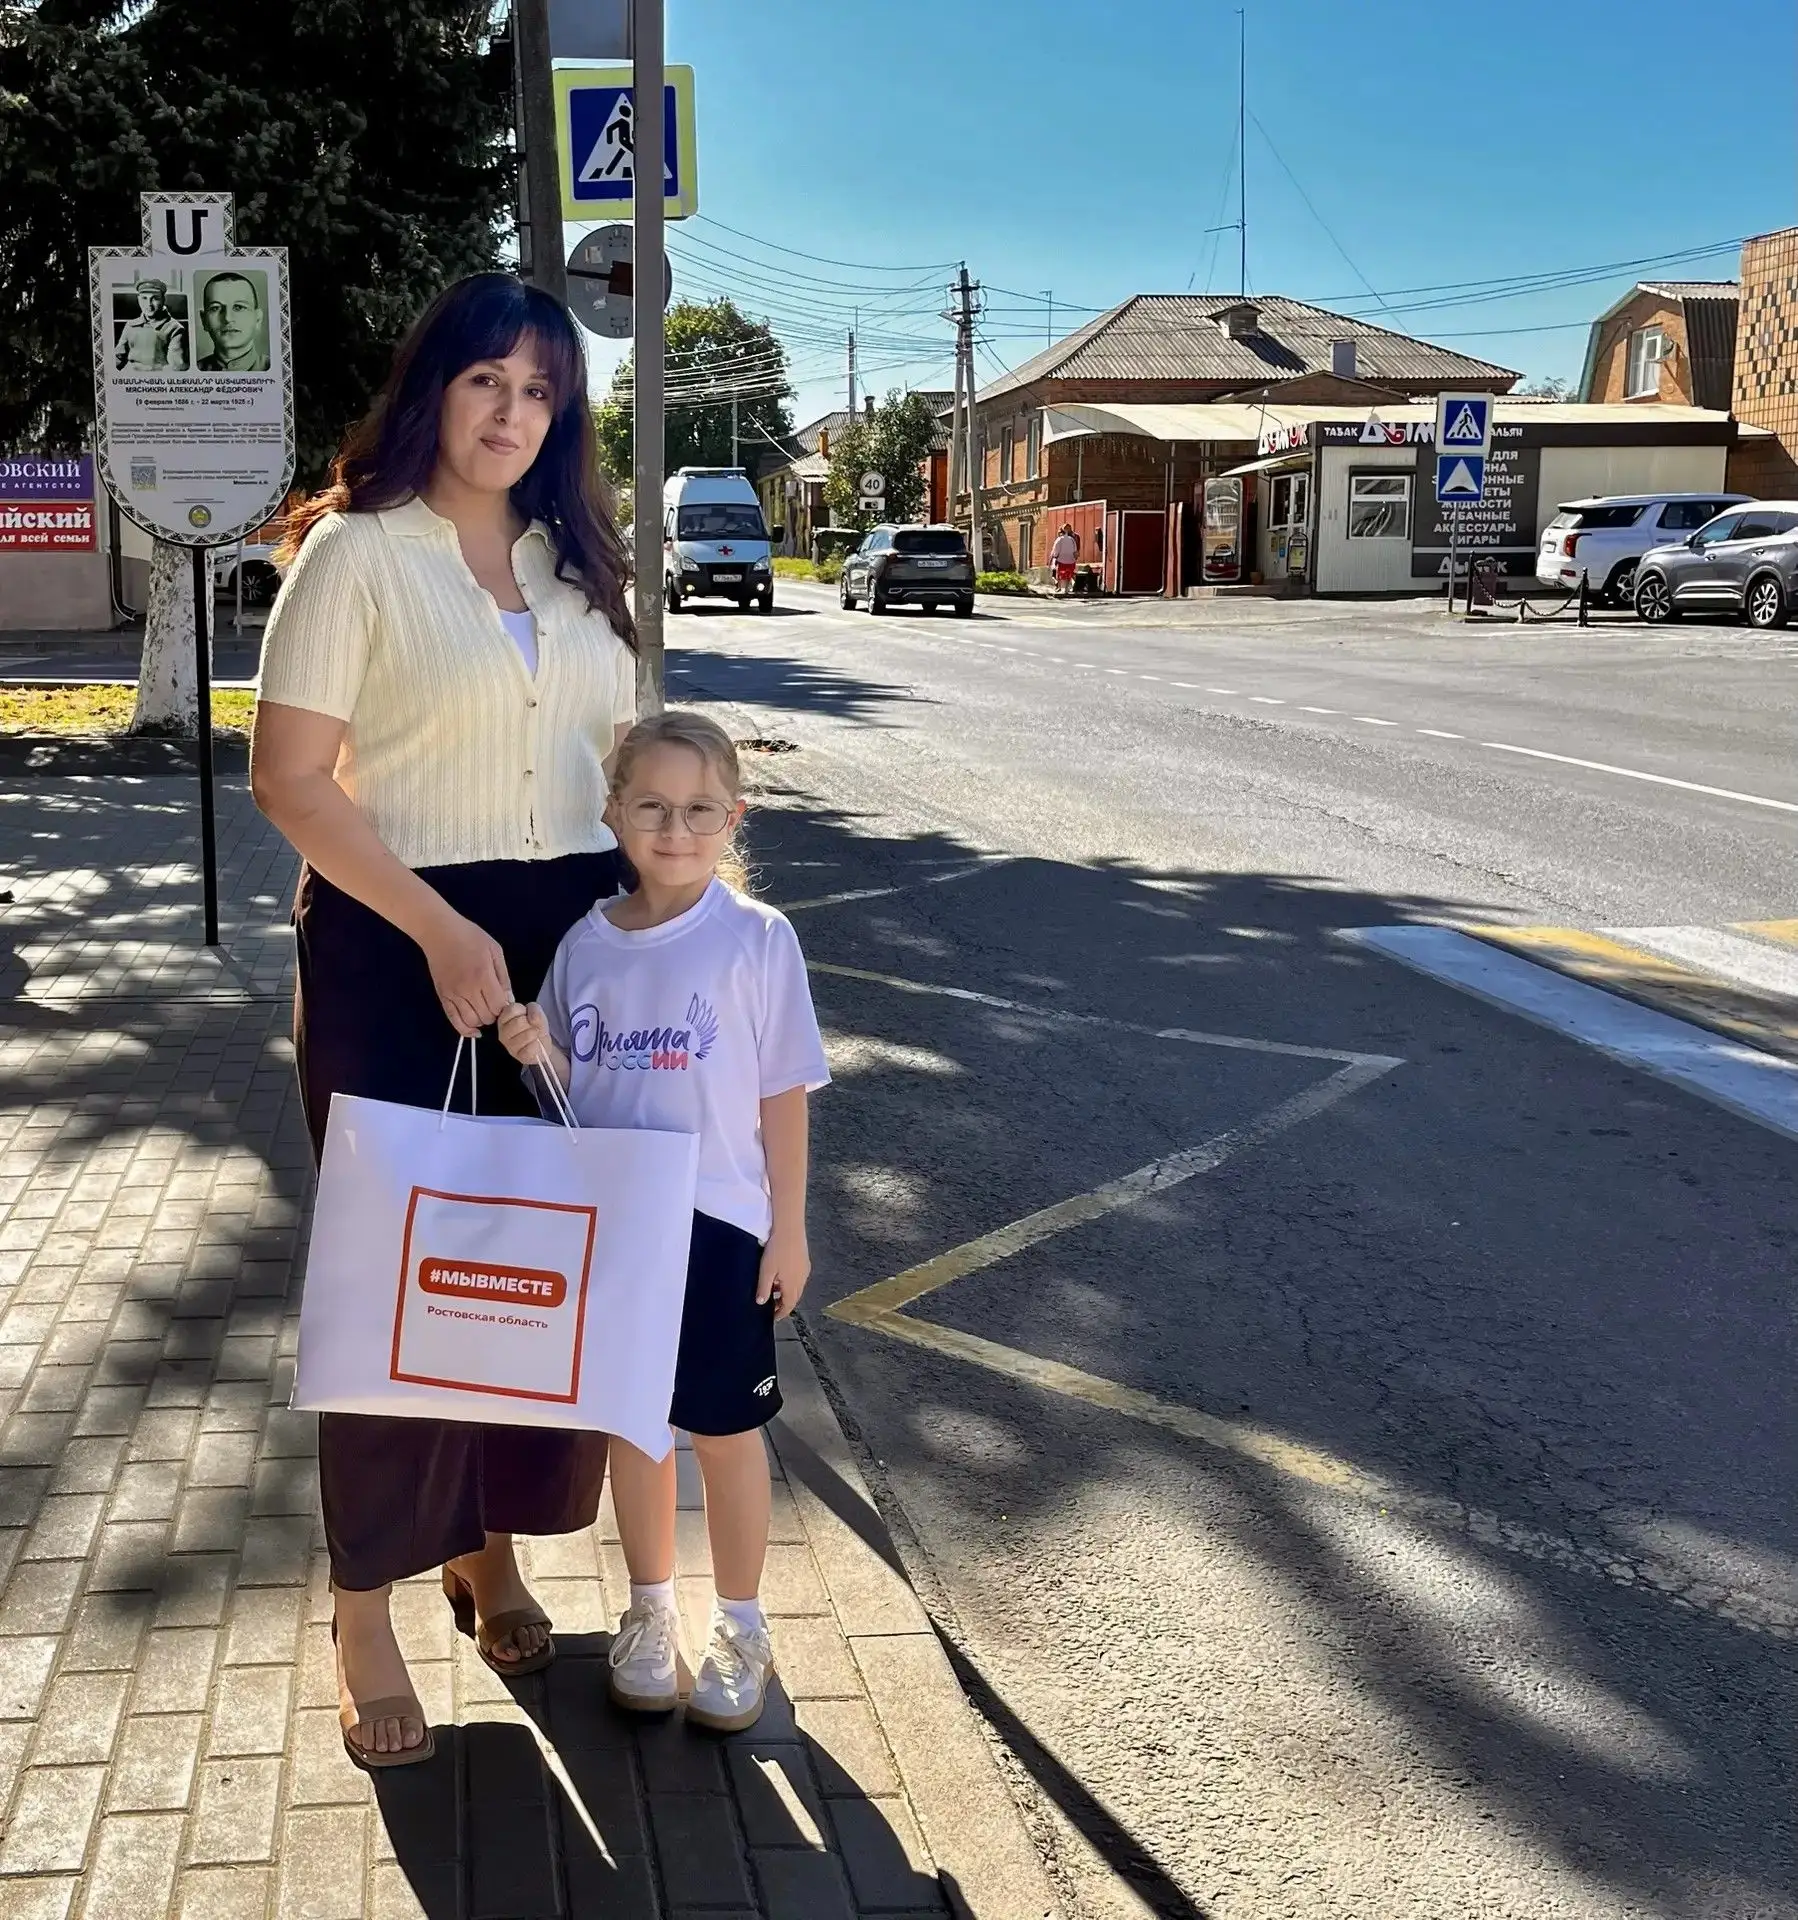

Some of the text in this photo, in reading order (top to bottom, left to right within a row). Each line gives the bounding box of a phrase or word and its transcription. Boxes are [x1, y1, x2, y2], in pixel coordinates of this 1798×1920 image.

[126, 385, 263, 394] МЯСНИКЯН АЛЕКСАНДР ФЁДОРОВИЧ
[144, 398, 173, 406] февраля
[1324, 413, 1523, 444] ТАБАК ДЫМ АЛЬЯН
[1258, 424, 1308, 455] ДЫМОК
[1492, 450, 1518, 461] ДЛЯ
[864, 479, 880, 490] 40
[0, 507, 91, 528] йский
[1441, 511, 1511, 520] ТАБАЧНЫЕ
[21, 532, 49, 543] всей
[53, 534, 90, 543] семьи
[570, 1003, 691, 1066] Орлята
[429, 1268, 554, 1297] #МЫВМЕСТЕ
[427, 1305, 548, 1329] Ростовская область
